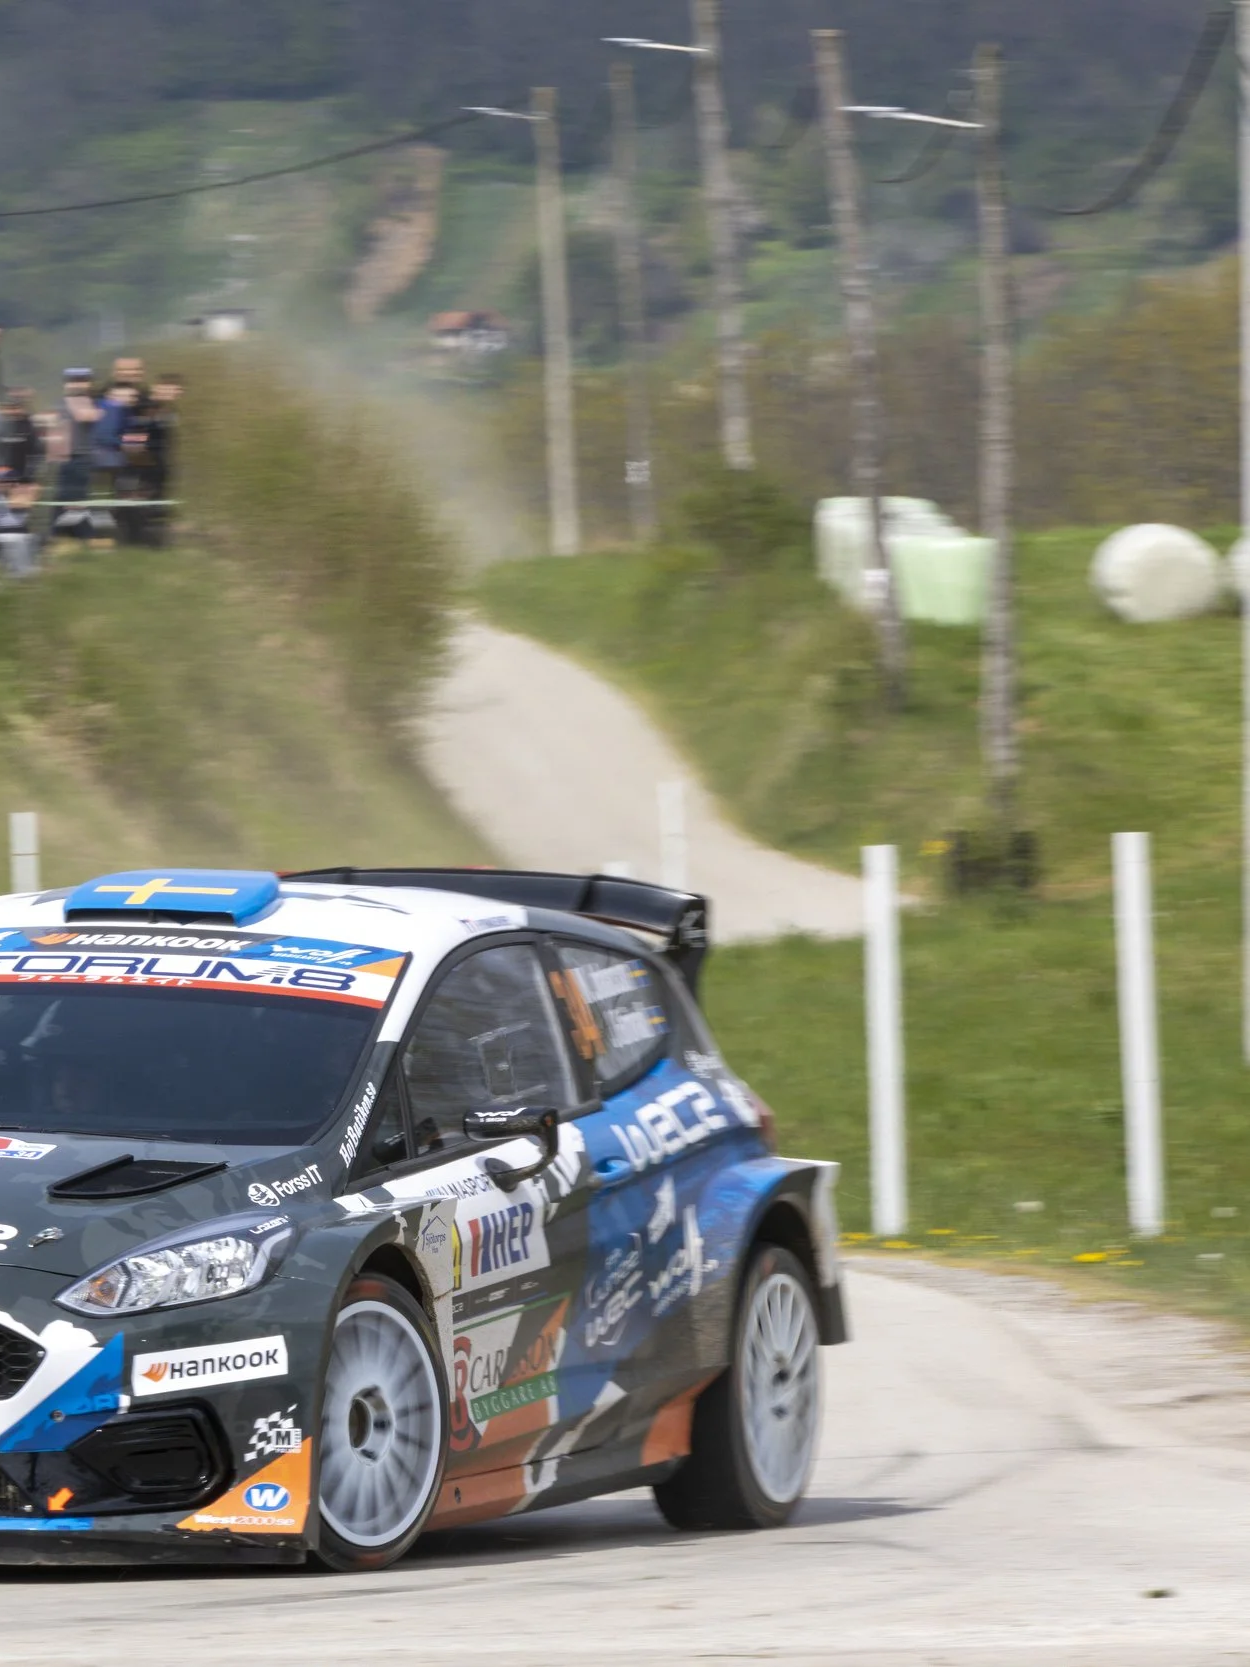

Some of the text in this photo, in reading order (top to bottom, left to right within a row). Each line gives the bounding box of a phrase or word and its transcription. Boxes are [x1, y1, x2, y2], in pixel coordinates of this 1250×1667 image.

[271, 1163, 324, 1198] Forss IT
[169, 1347, 279, 1381] HANKOOK
[249, 1488, 288, 1507] W
